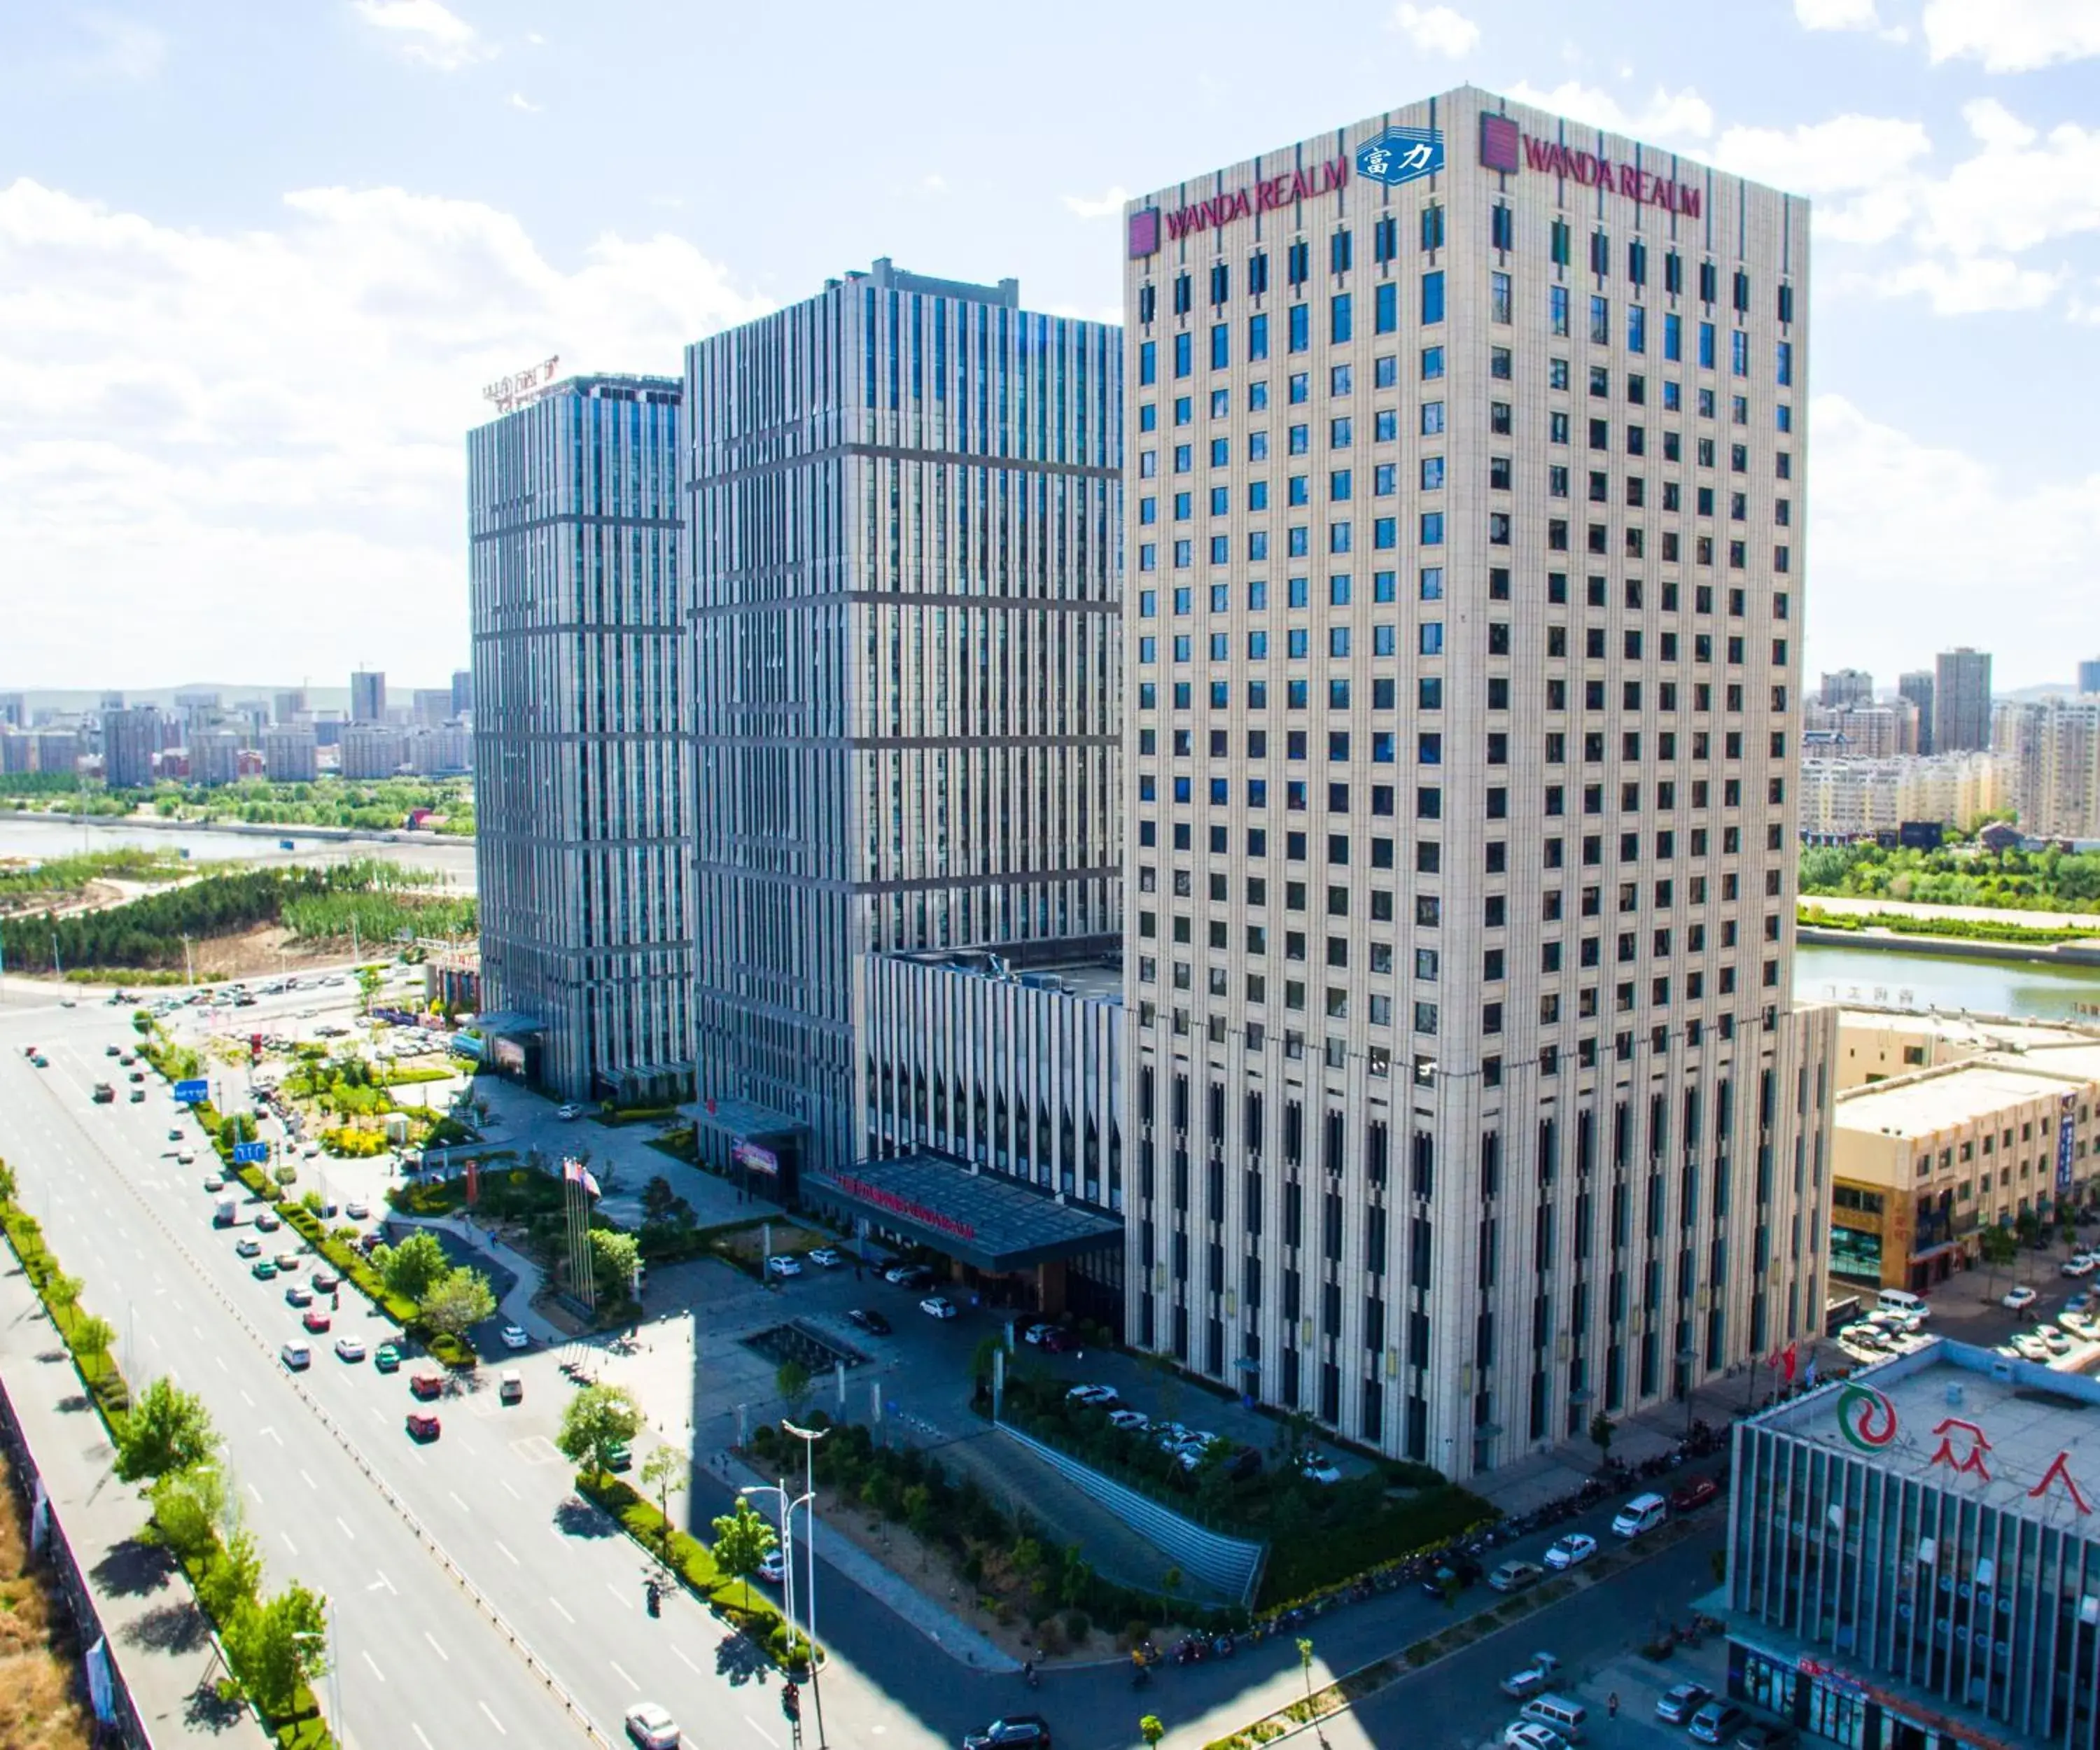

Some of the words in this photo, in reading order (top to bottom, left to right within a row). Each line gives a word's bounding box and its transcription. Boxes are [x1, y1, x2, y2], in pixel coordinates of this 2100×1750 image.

[1166, 187, 1252, 240] WANDA
[1254, 155, 1348, 214] REALM
[1364, 144, 1433, 174] 富力
[1522, 133, 1616, 192] WANDA
[1620, 164, 1701, 219] REALM
